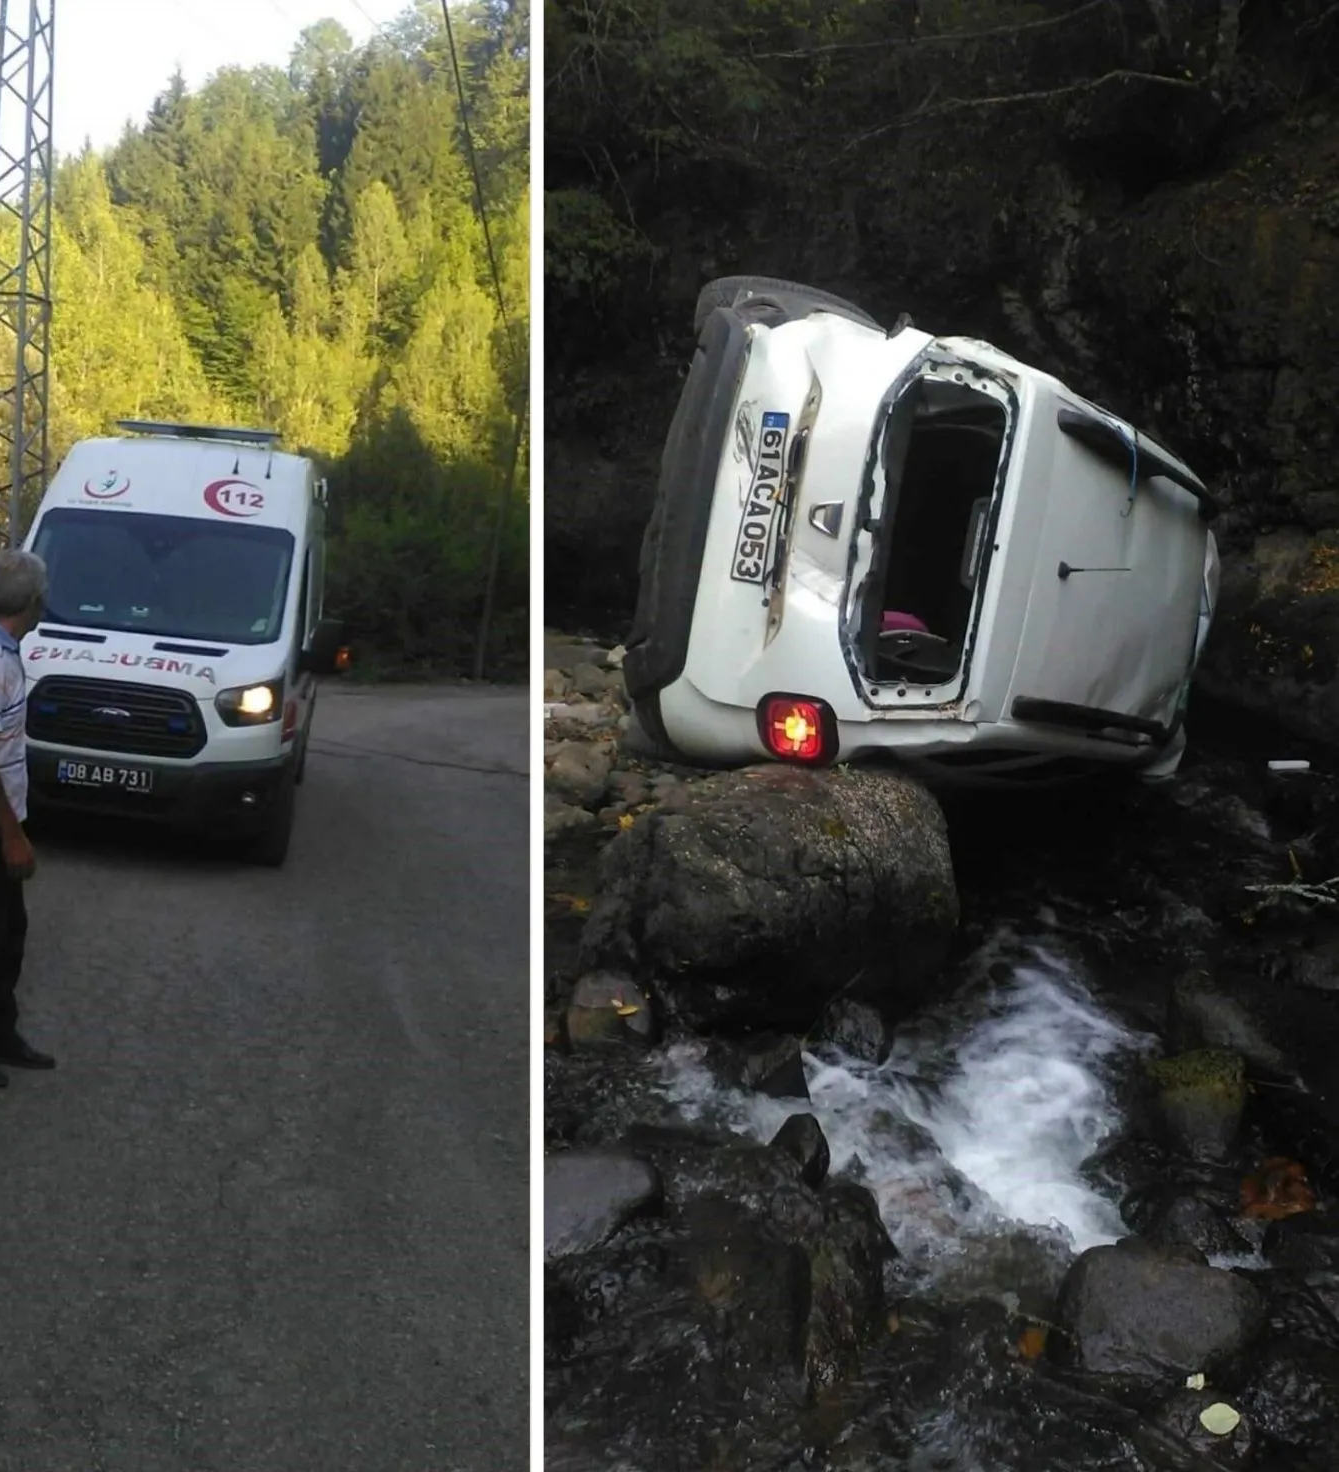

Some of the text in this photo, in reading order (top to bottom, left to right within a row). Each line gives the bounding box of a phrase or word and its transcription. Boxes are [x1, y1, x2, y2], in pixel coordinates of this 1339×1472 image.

[220, 490, 264, 509] 112
[736, 430, 782, 579] 61ACA053
[67, 763, 146, 786] 08 AB 731
